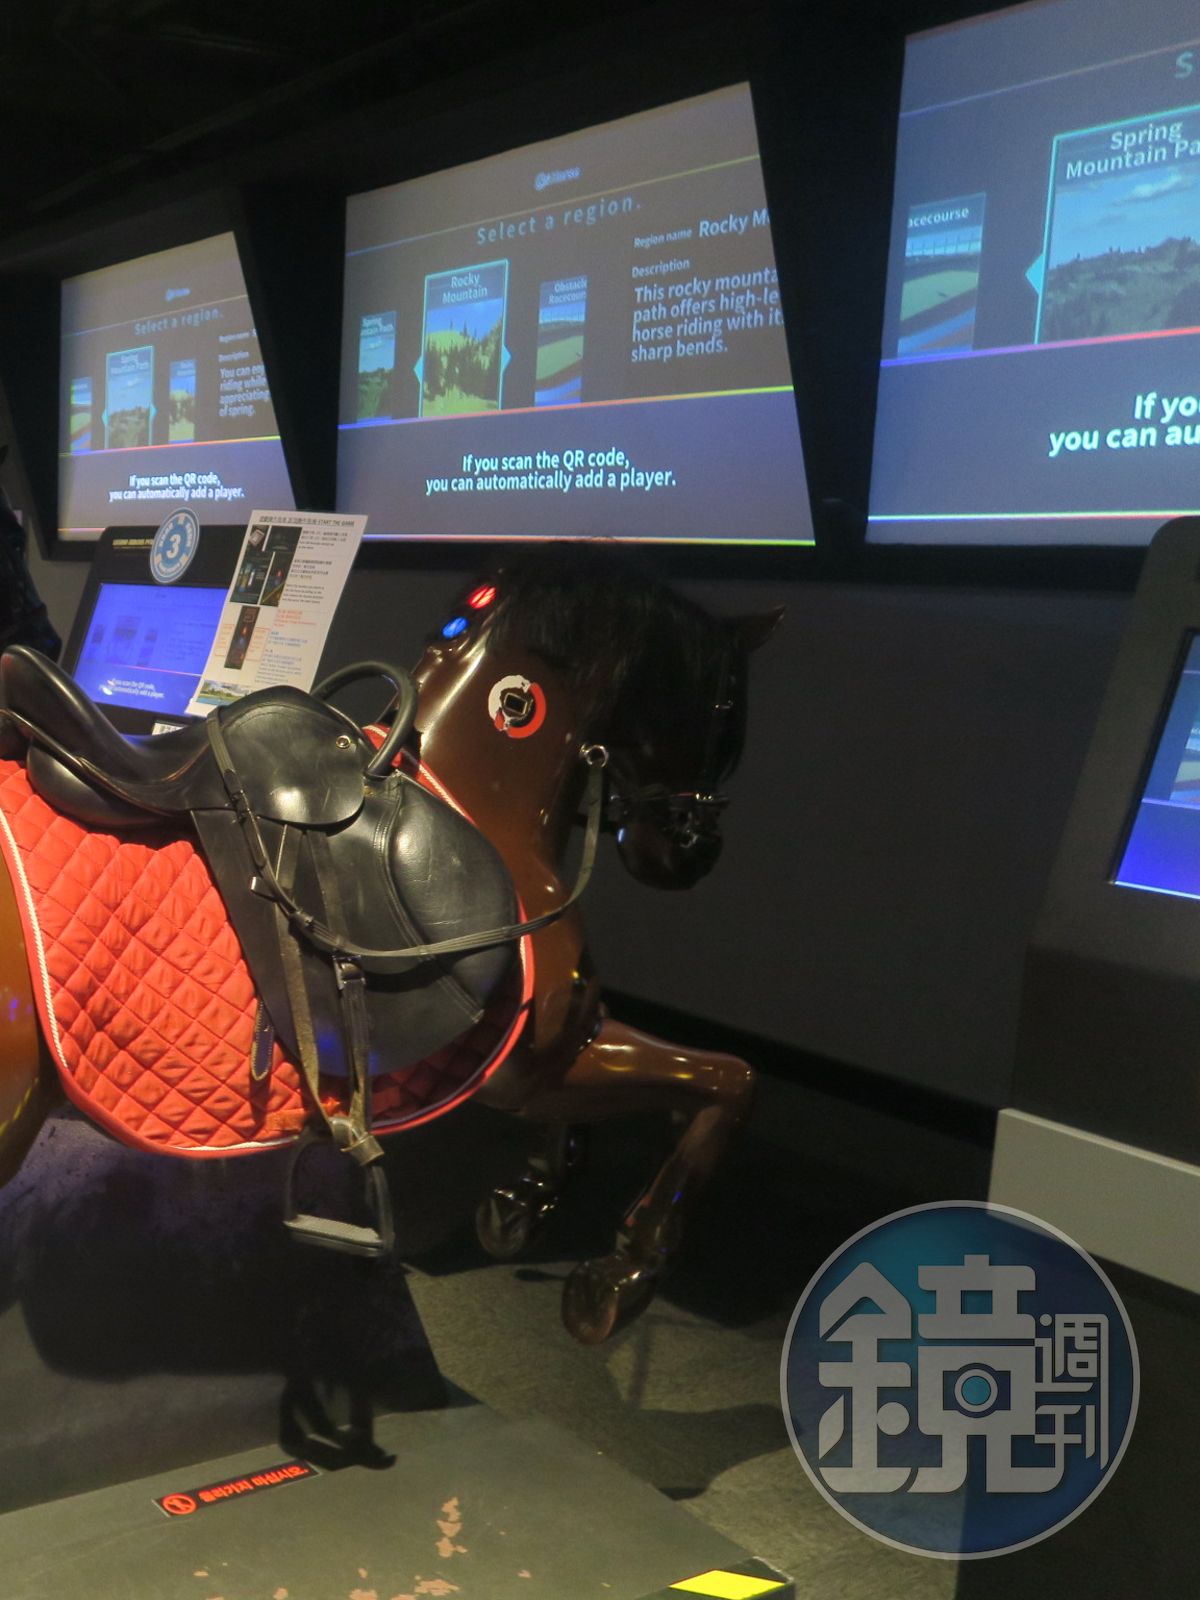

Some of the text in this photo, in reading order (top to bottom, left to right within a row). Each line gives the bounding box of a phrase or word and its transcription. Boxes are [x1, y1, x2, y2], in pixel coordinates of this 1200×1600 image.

[1111, 121, 1184, 150] Spring
[1066, 140, 1200, 180] Mountain Pa
[476, 196, 642, 245] Select a region.
[634, 233, 664, 248] Region
[666, 229, 692, 241] name
[699, 214, 748, 237] Rocky
[907, 206, 970, 228] acecourse
[451, 273, 480, 289] Rocky
[632, 259, 690, 278] Description
[442, 286, 488, 303] Mountain
[635, 268, 778, 303] This rocky mounta
[634, 287, 779, 323] path offers high-le
[134, 317, 168, 335] Select
[632, 307, 784, 342] horse riding with it
[632, 338, 728, 362] sharp bends.
[1134, 392, 1200, 424] If yo
[1049, 424, 1200, 457] you can au
[463, 447, 630, 475] If you scan the QR code,
[109, 485, 245, 502] you can automatically add a player.
[129, 472, 221, 489] If you scan the QR code,
[425, 468, 676, 496] you can automatically add a player.
[166, 533, 181, 559] 3
